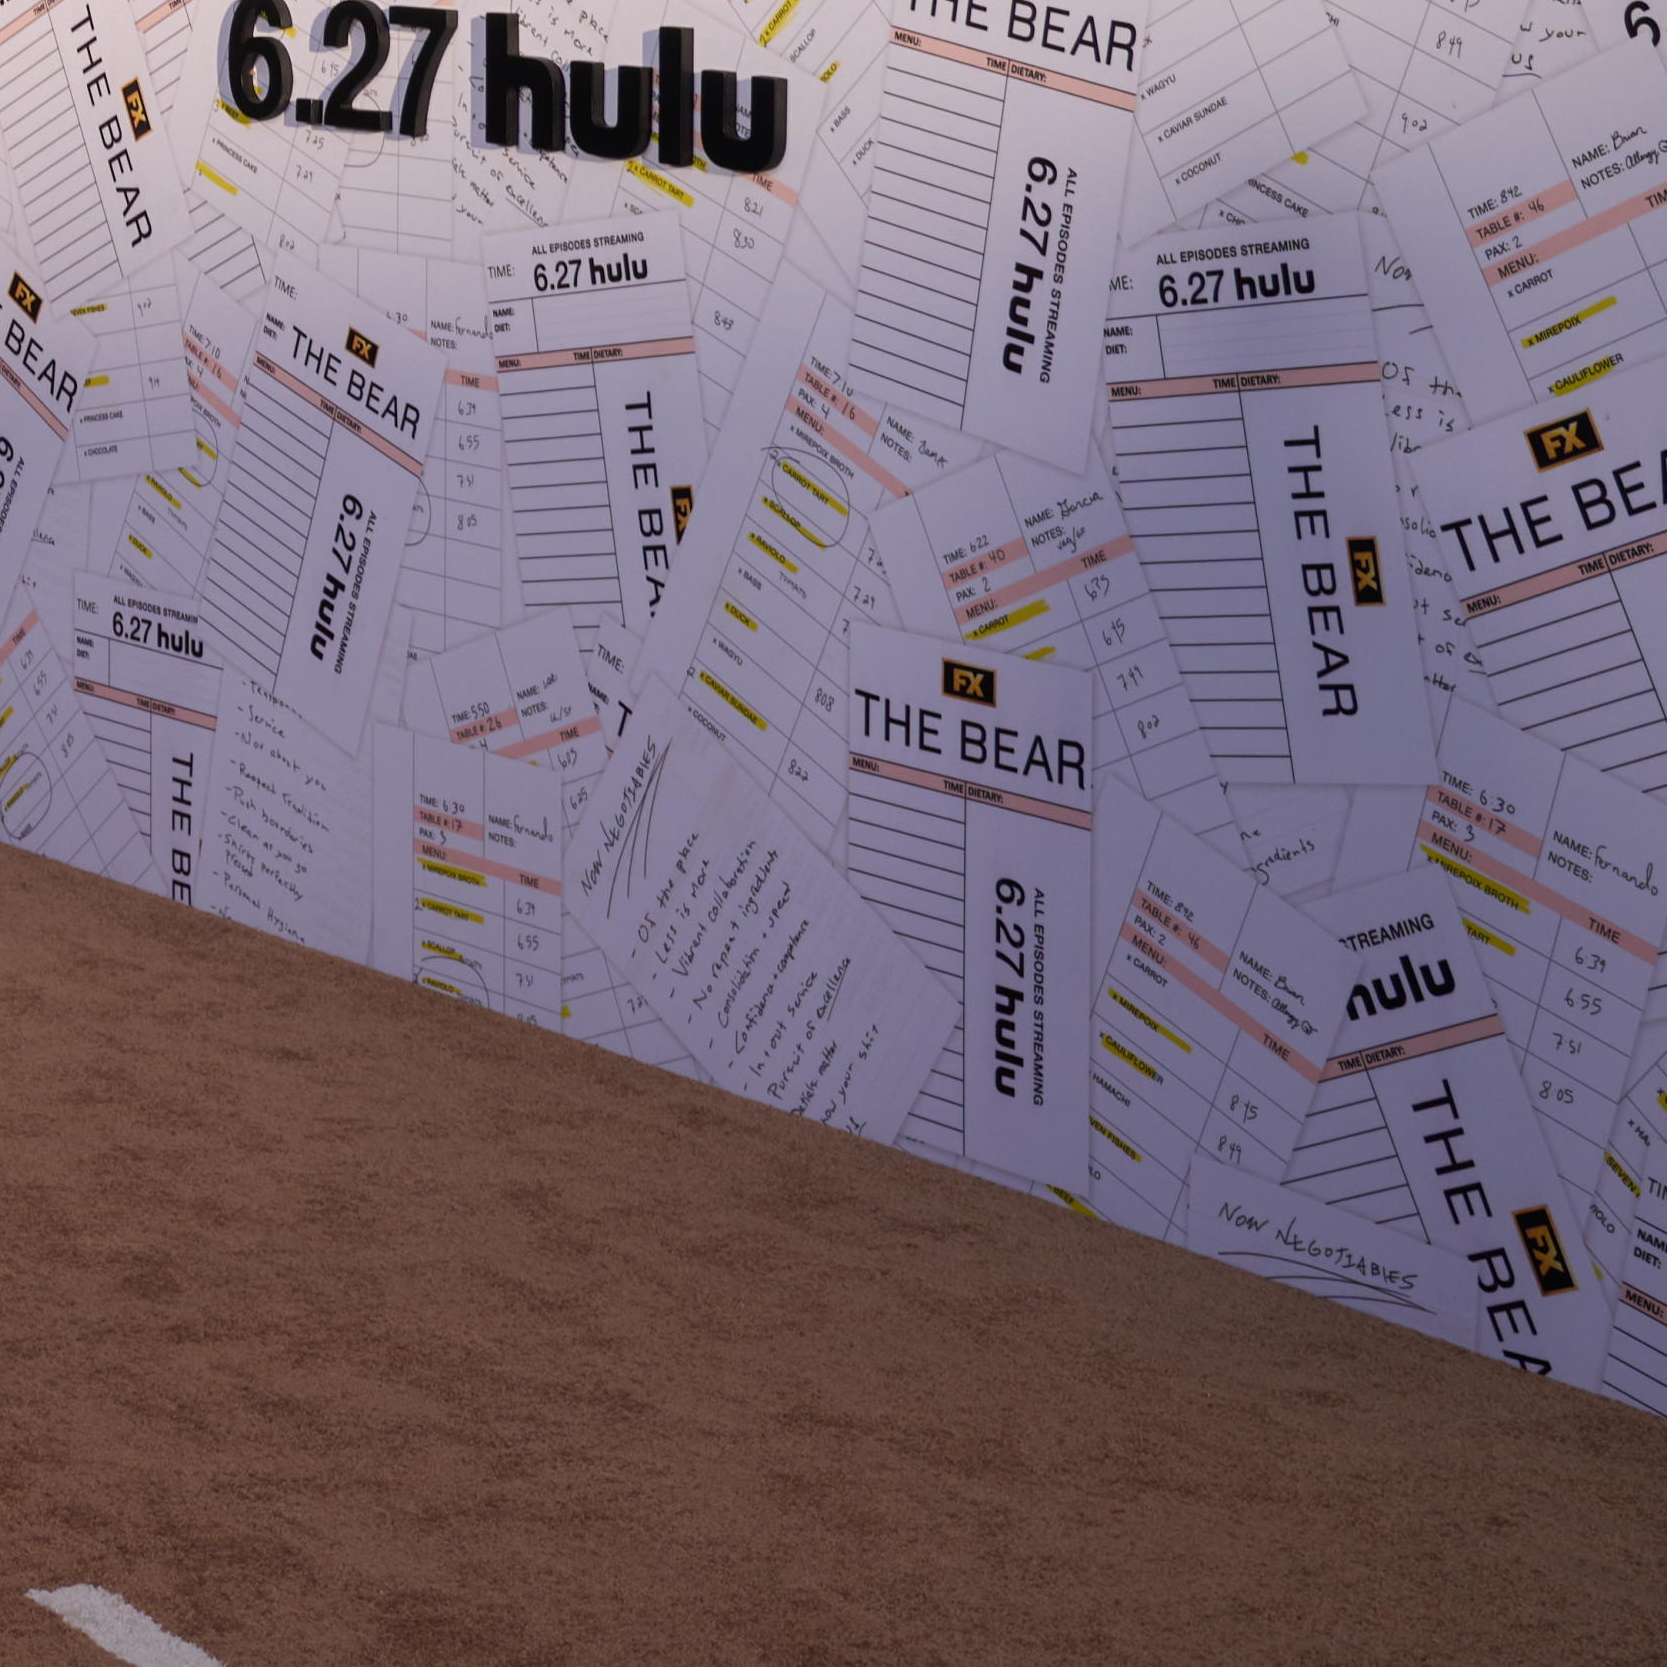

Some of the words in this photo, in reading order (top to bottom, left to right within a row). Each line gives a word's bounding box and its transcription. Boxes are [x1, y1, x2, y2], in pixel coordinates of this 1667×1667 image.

[69, 4, 110, 107] THE
[98, 124, 154, 249] BEAR
[485, 11, 789, 173] hulu
[533, 259, 584, 292] 6.27
[589, 254, 648, 285] hulu
[1155, 252, 1178, 267] ALL
[1179, 244, 1238, 265] EPISODES
[1238, 237, 1310, 260] STREAMING
[1157, 269, 1226, 313] 6.27
[1233, 263, 1316, 301] hulu
[290, 326, 340, 387] THE
[346, 367, 421, 440] BEAR
[1283, 425, 1330, 540] THE
[335, 493, 364, 571] 6.27
[309, 573, 346, 661] hulu
[1300, 562, 1358, 718] BEAR
[855, 688, 942, 756] THE
[960, 719, 1086, 791] BEAR
[1443, 771, 1473, 796] TIME:
[1553, 831, 1593, 860] NAME:
[995, 877, 1026, 978] 6.27
[1034, 887, 1044, 910] ALL
[1032, 921, 1045, 1004] EPISODES
[995, 985, 1025, 1098] hulu
[1032, 1005, 1045, 1106] STREAMING
